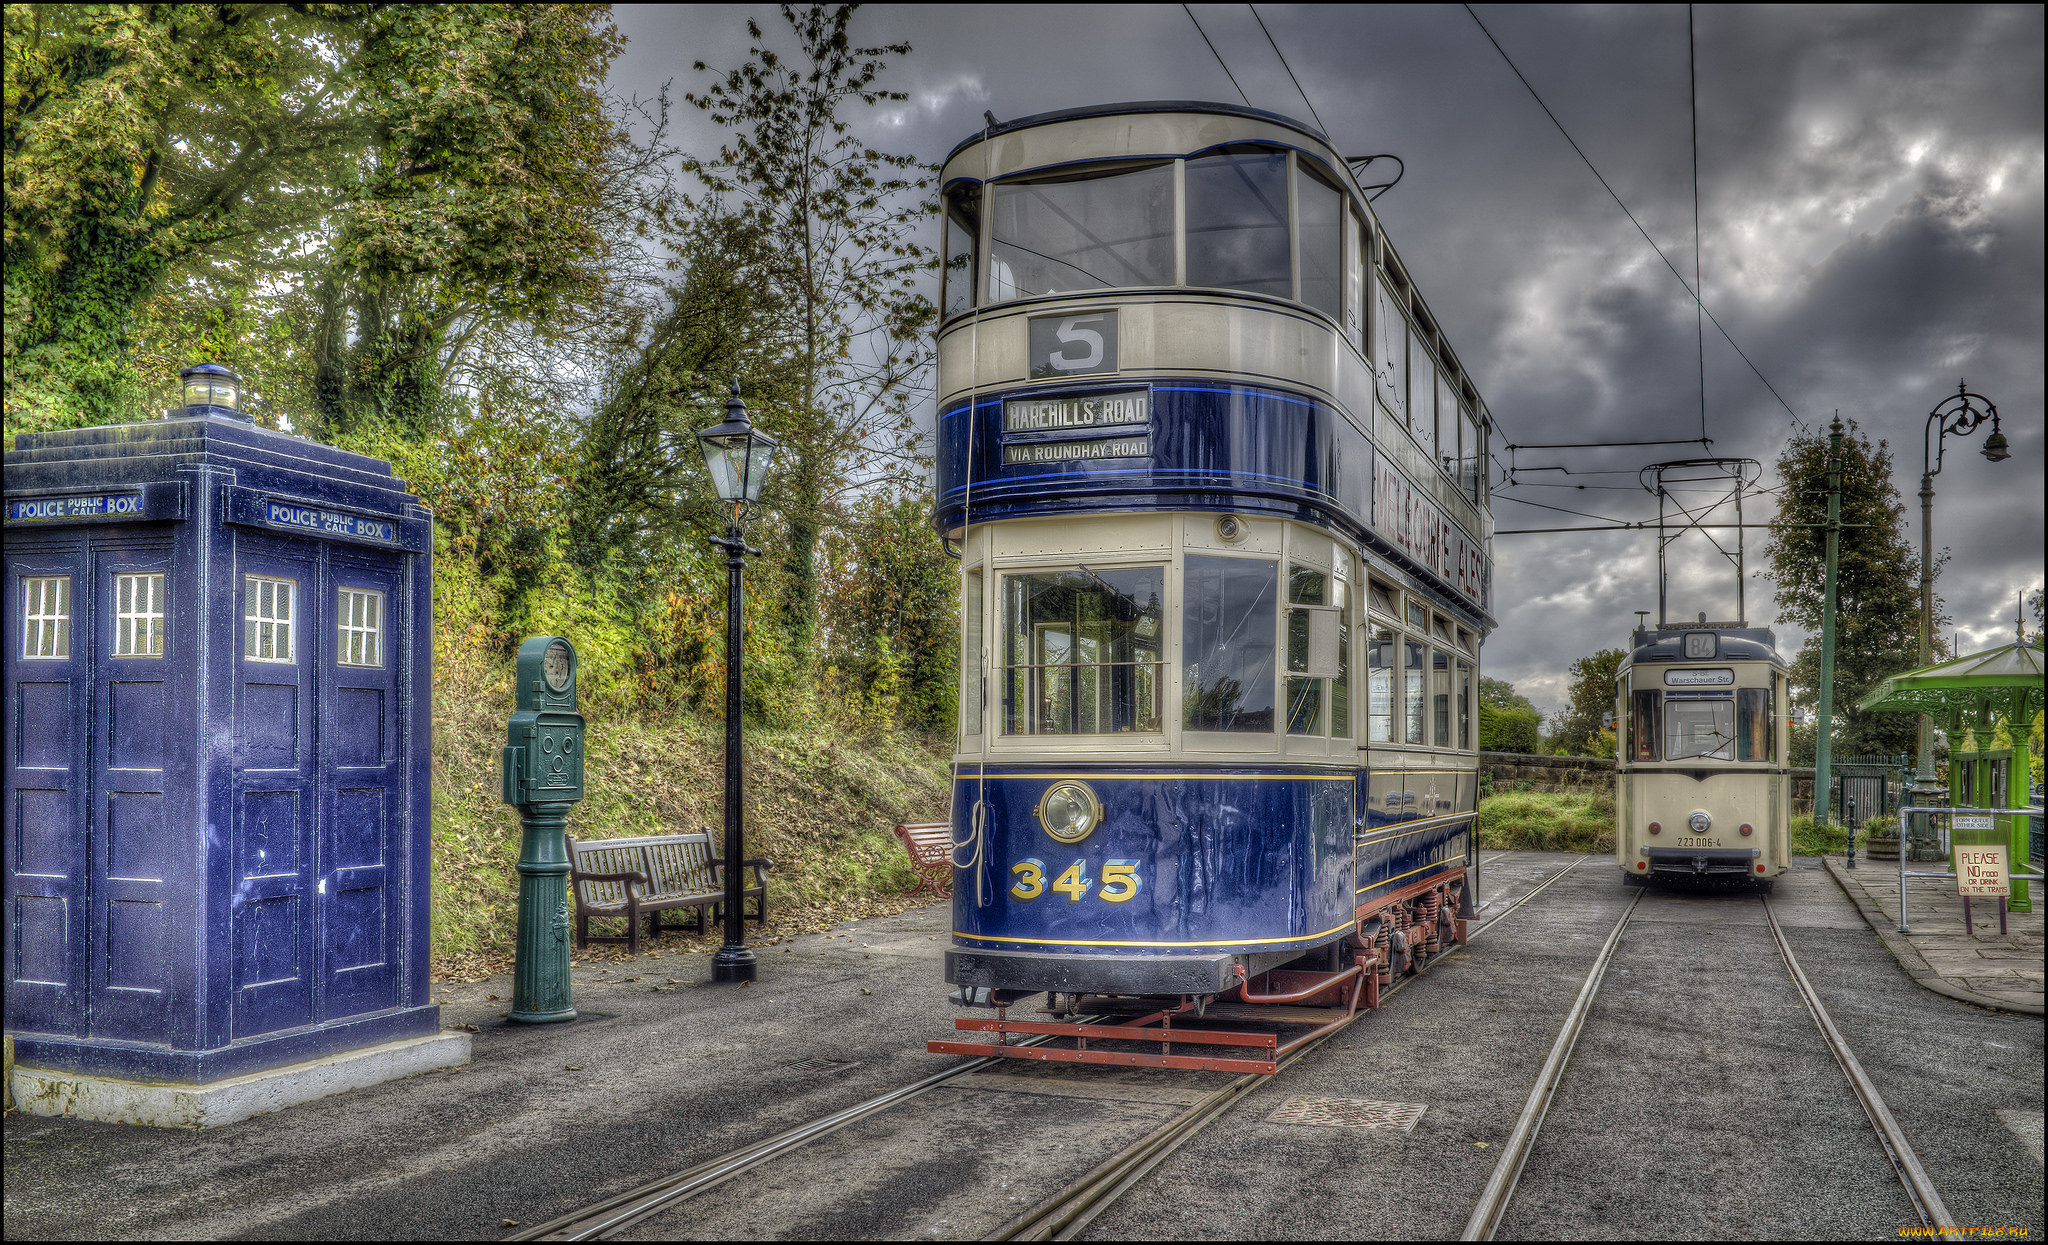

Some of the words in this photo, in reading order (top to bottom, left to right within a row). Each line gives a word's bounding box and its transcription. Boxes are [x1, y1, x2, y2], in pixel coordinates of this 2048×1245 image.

[1049, 316, 1104, 371] 5
[1009, 402, 1094, 429] HAREHILLS
[1103, 397, 1147, 422] ROAD
[1010, 446, 1031, 462] VIA
[1035, 442, 1106, 461] ROUNDHAY
[1112, 441, 1148, 457] ROAD
[18, 501, 64, 518] POLICE
[67, 497, 103, 508] PUBLIC
[107, 497, 138, 513] BOX
[72, 507, 99, 516] CALL
[271, 504, 318, 527] POLICE
[320, 511, 354, 526] PUBLIC
[325, 522, 350, 534] CALL
[357, 520, 384, 537] BOX
[1458, 538, 1482, 602] ALES
[1691, 637, 1711, 656] 84
[1671, 676, 1716, 684] Warschauer
[1717, 675, 1730, 683] Str.
[1677, 837, 1694, 847] 223
[1696, 837, 1721, 847] 006-4
[1962, 853, 1999, 864] PLEASE
[1968, 866, 1980, 877] NO
[1009, 857, 1142, 905] 345
